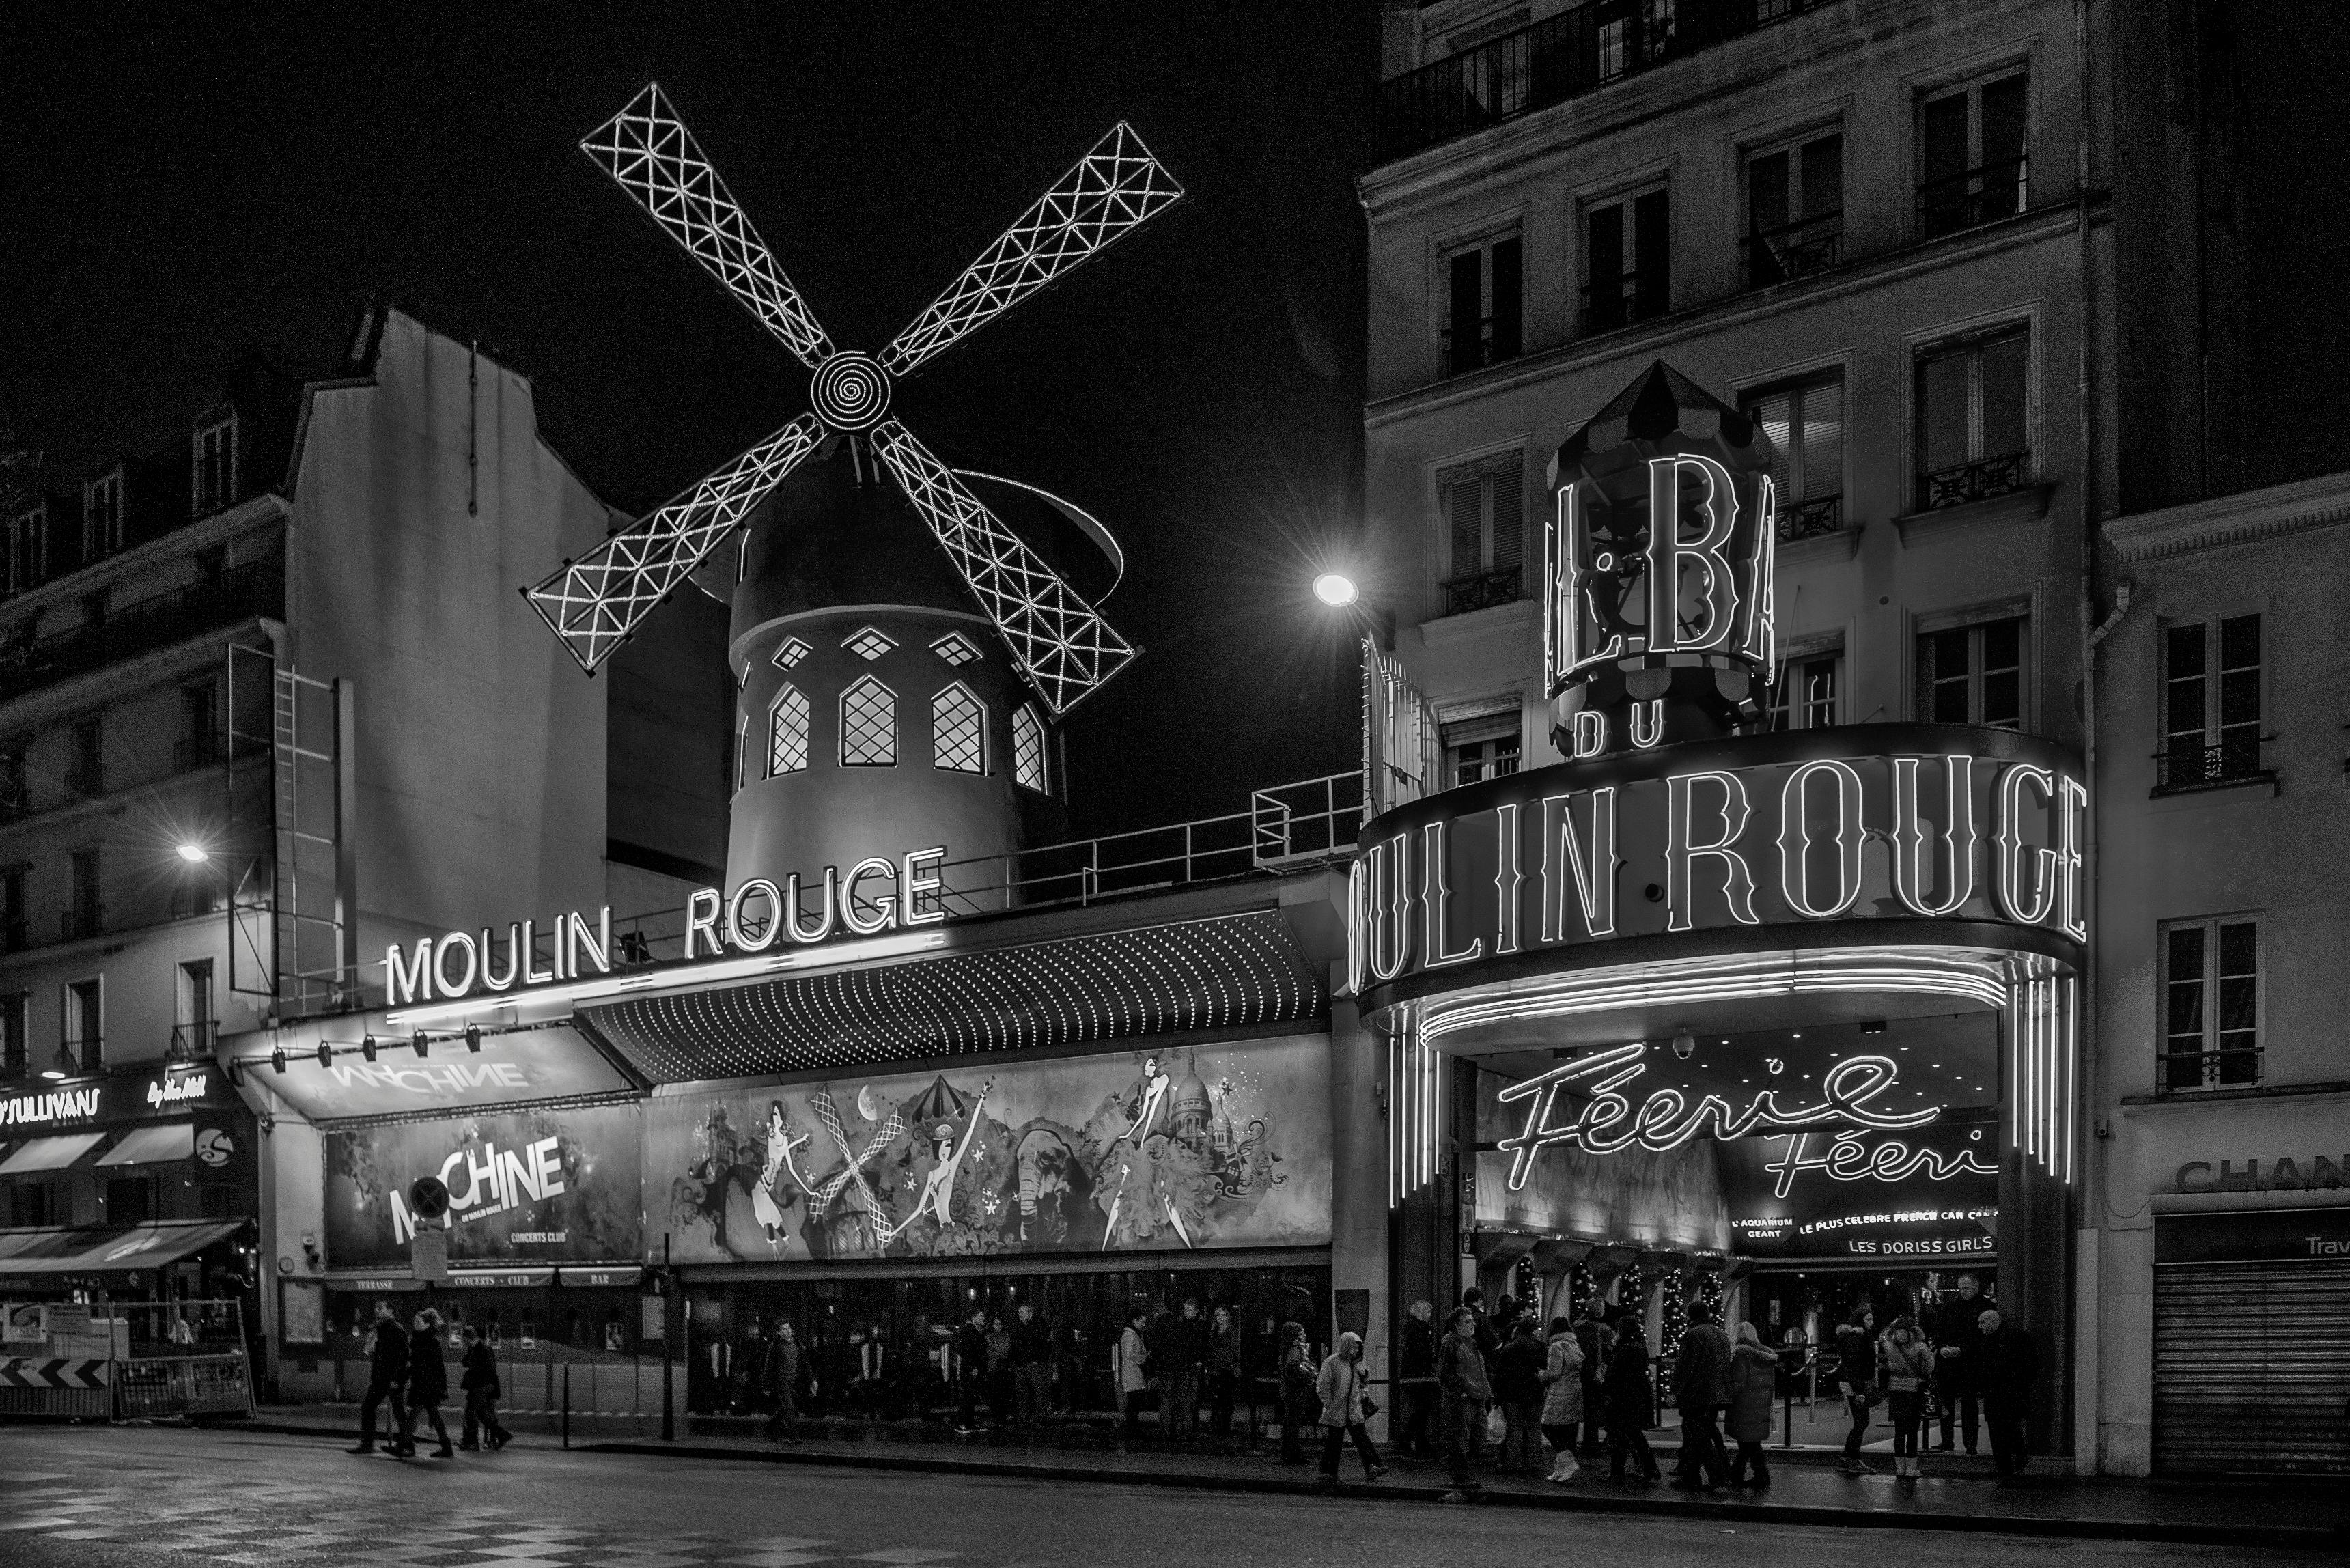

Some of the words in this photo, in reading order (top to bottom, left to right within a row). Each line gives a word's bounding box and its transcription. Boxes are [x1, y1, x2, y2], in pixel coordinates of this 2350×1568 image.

[1573, 699, 1664, 758] DU
[1664, 754, 2087, 945] ROUGE
[386, 906, 614, 1007] MOULIN
[685, 846, 951, 959] ROUGE
[1498, 1043, 1940, 1191] Féerie
[389, 1136, 565, 1245] MCHINE
[511, 1231, 546, 1243] CONCERTS
[548, 1231, 566, 1242] CLUB
[1800, 1224, 1813, 1235] LE
[1816, 1219, 1843, 1231] PLUS
[1893, 1211, 1938, 1222] FRENCH
[1941, 1212, 1963, 1220] CAN
[1849, 1240, 1876, 1252] LES
[1882, 1241, 1942, 1254] DORISS
[1946, 1236, 1993, 1252] GIRLS
[507, 1275, 529, 1285] CLUB
[591, 1274, 609, 1285] BAR
